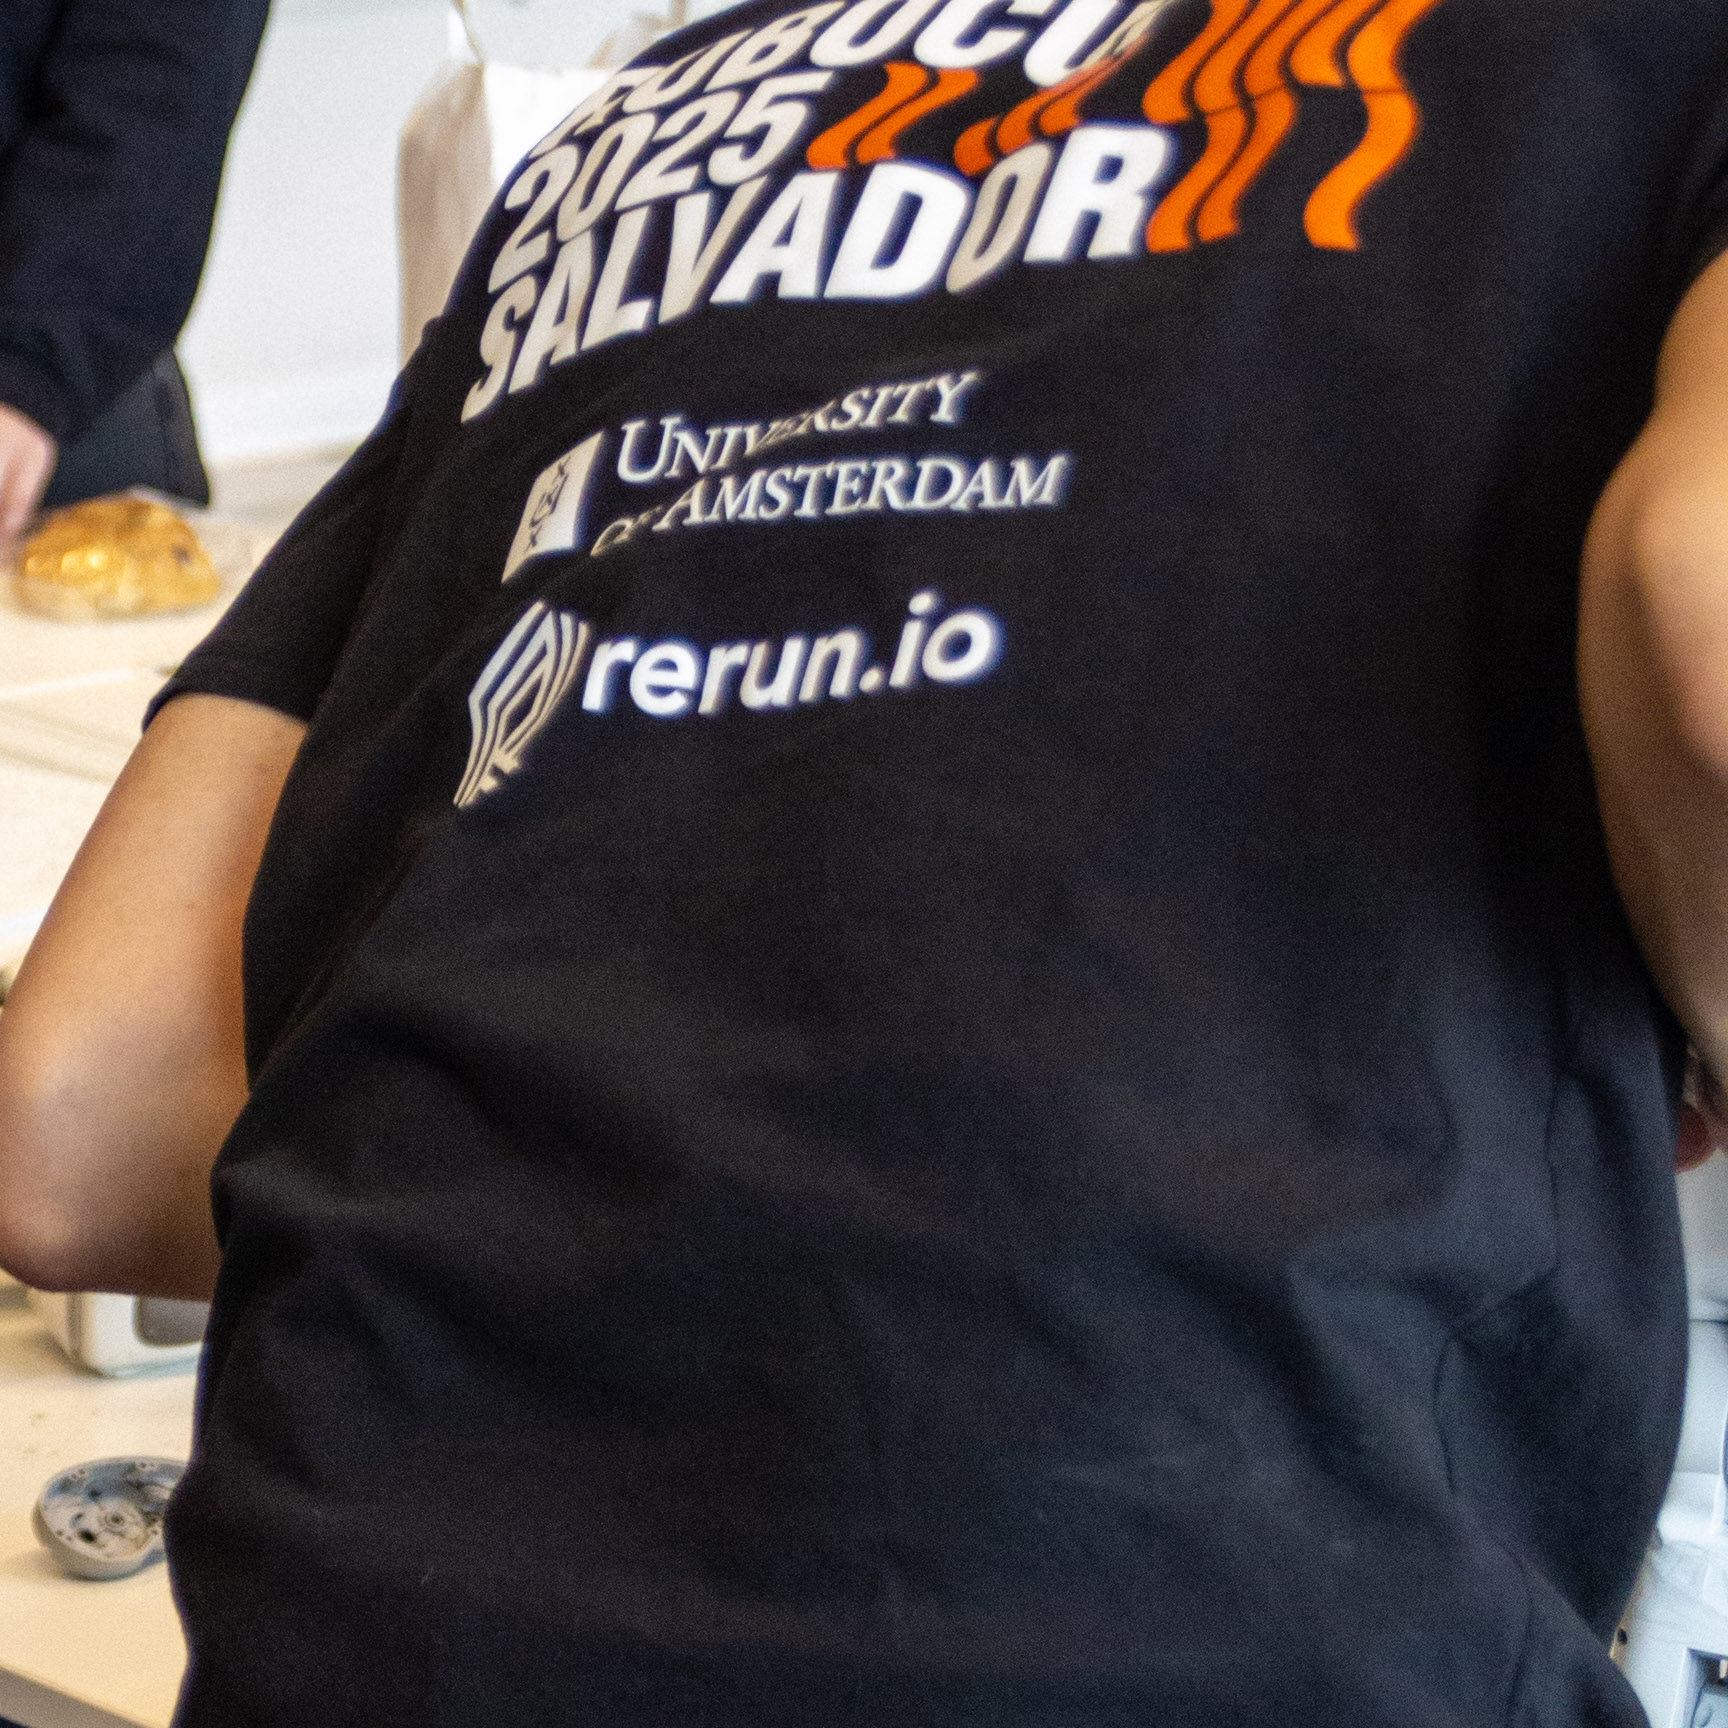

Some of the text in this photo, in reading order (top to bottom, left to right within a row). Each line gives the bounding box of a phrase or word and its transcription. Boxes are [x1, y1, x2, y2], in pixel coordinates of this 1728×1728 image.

[460, 122, 1173, 424] SALVADOR
[487, 71, 835, 293] 2025
[581, 588, 1003, 718] rerun.io
